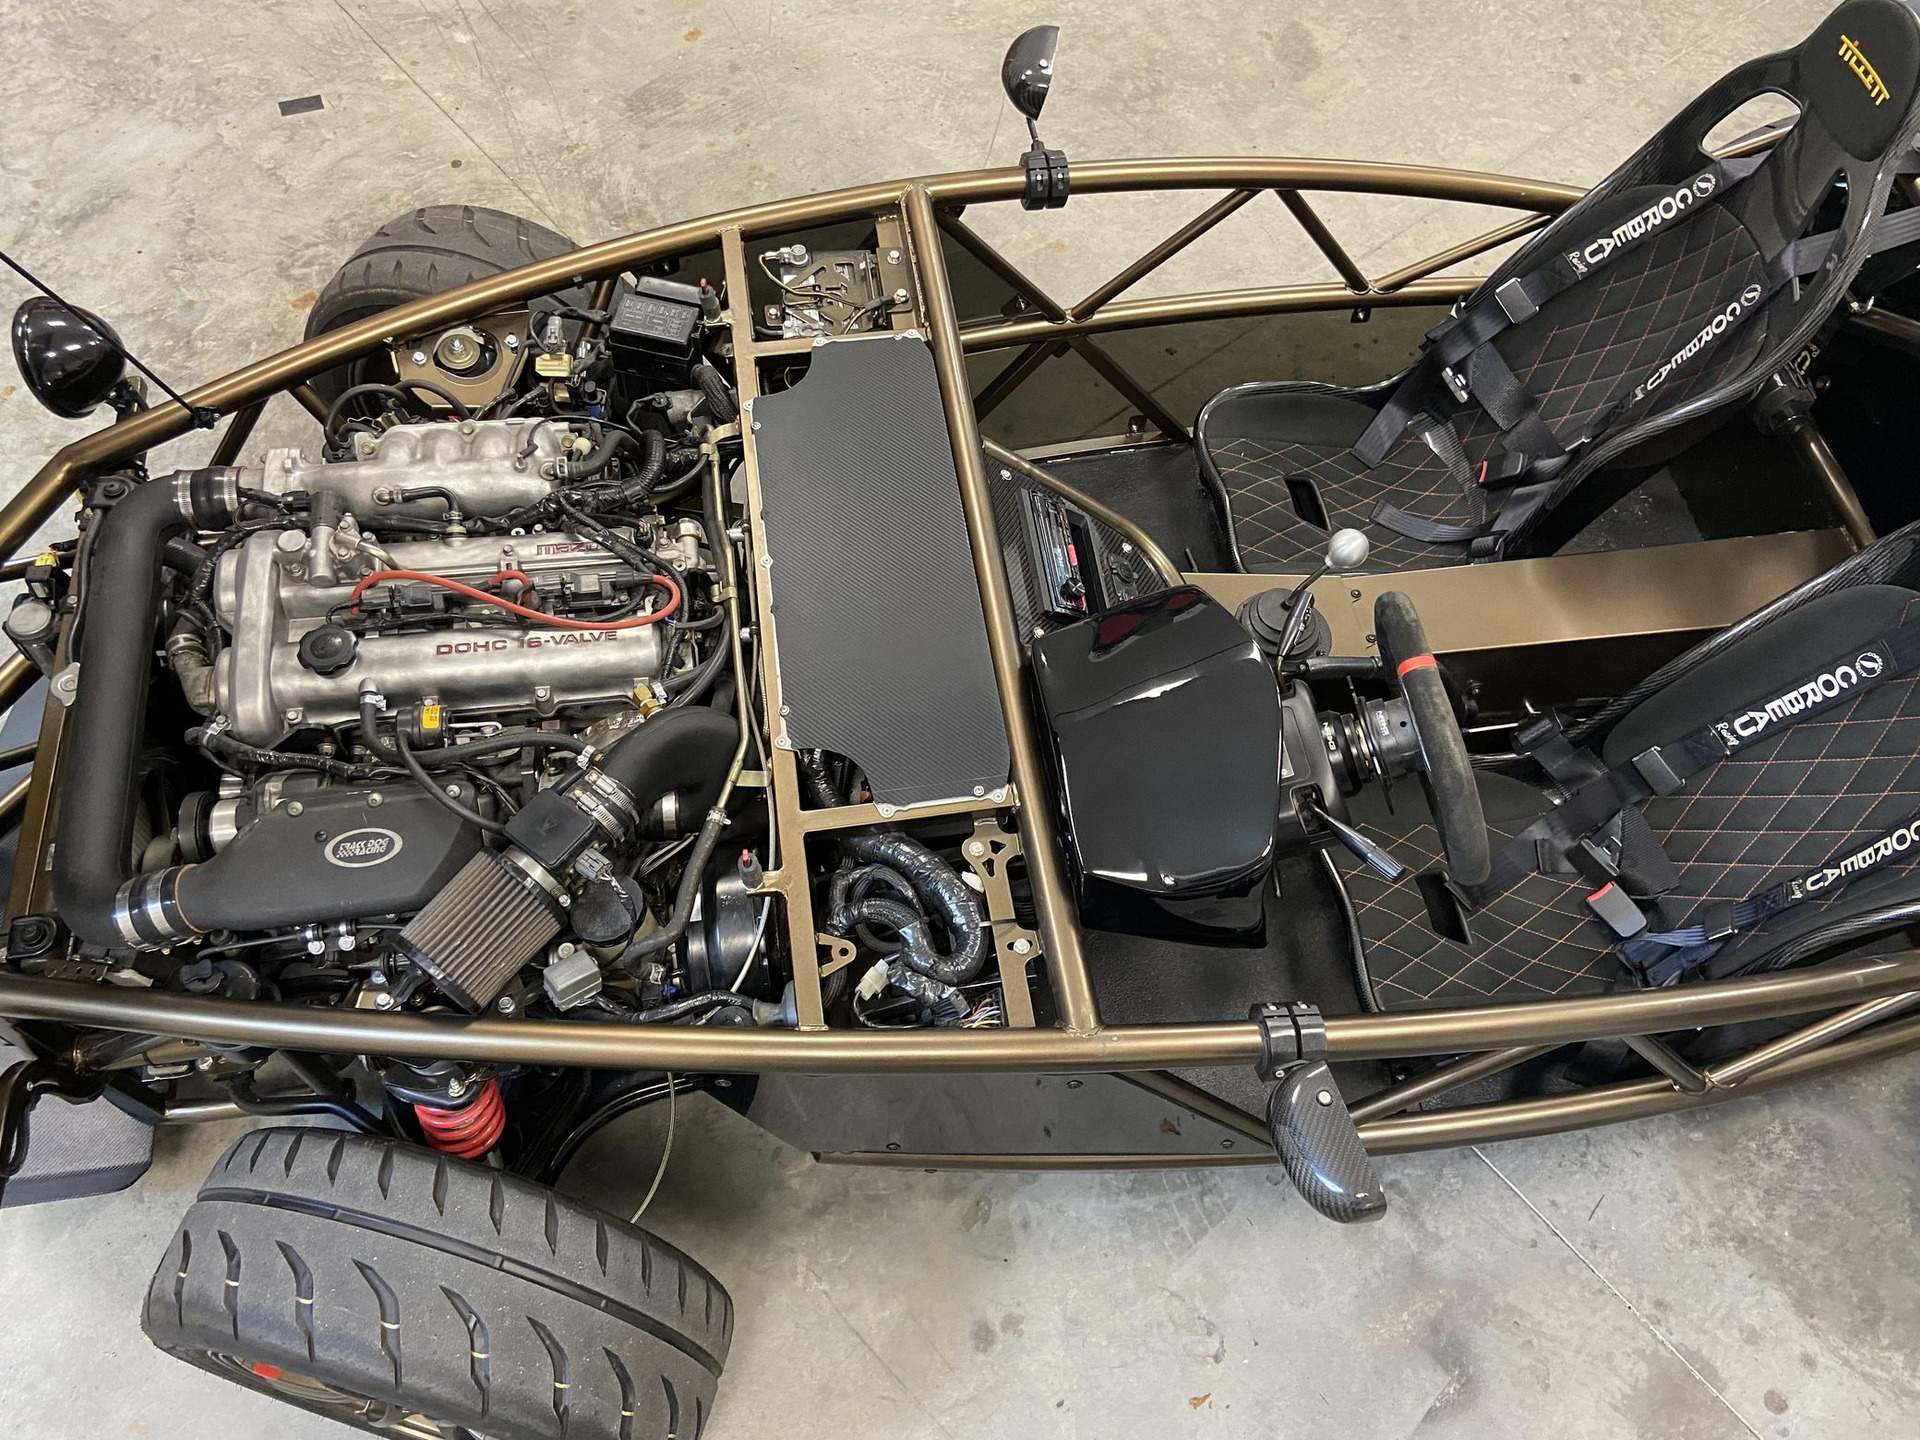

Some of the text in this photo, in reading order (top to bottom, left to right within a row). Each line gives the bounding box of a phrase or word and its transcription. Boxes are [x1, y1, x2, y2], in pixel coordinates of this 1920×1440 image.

[1584, 187, 1693, 264] CORBEAU
[1647, 302, 1741, 391] CORBEAU
[436, 631, 618, 656] DOHC 16-VALVE
[1733, 665, 1858, 737] CORBEAU
